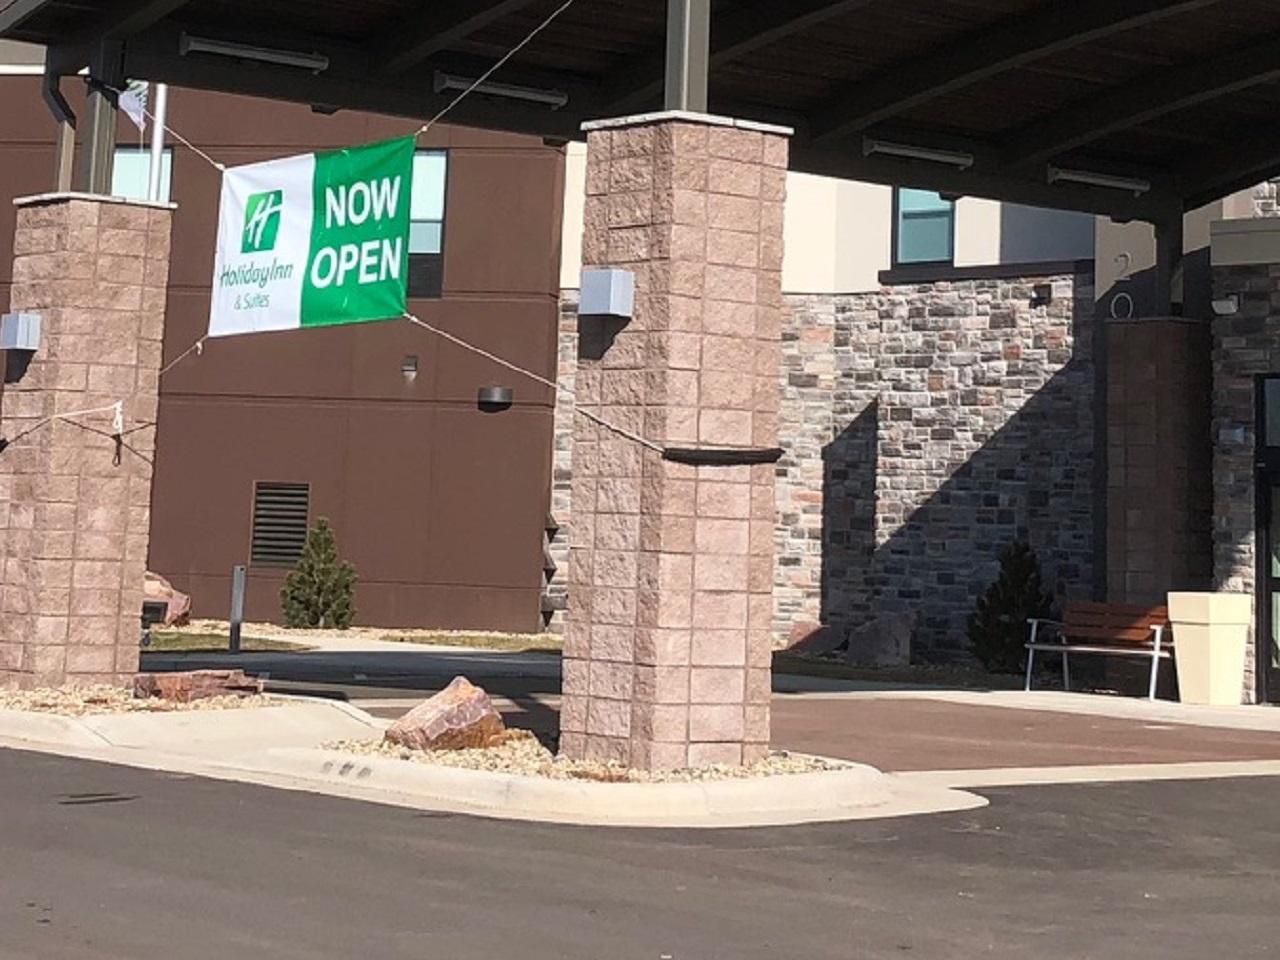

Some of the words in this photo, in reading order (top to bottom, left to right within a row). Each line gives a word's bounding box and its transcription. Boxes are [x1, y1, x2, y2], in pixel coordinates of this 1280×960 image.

[324, 175, 401, 229] NOW
[309, 236, 403, 289] OPEN
[243, 292, 270, 310] Suites
